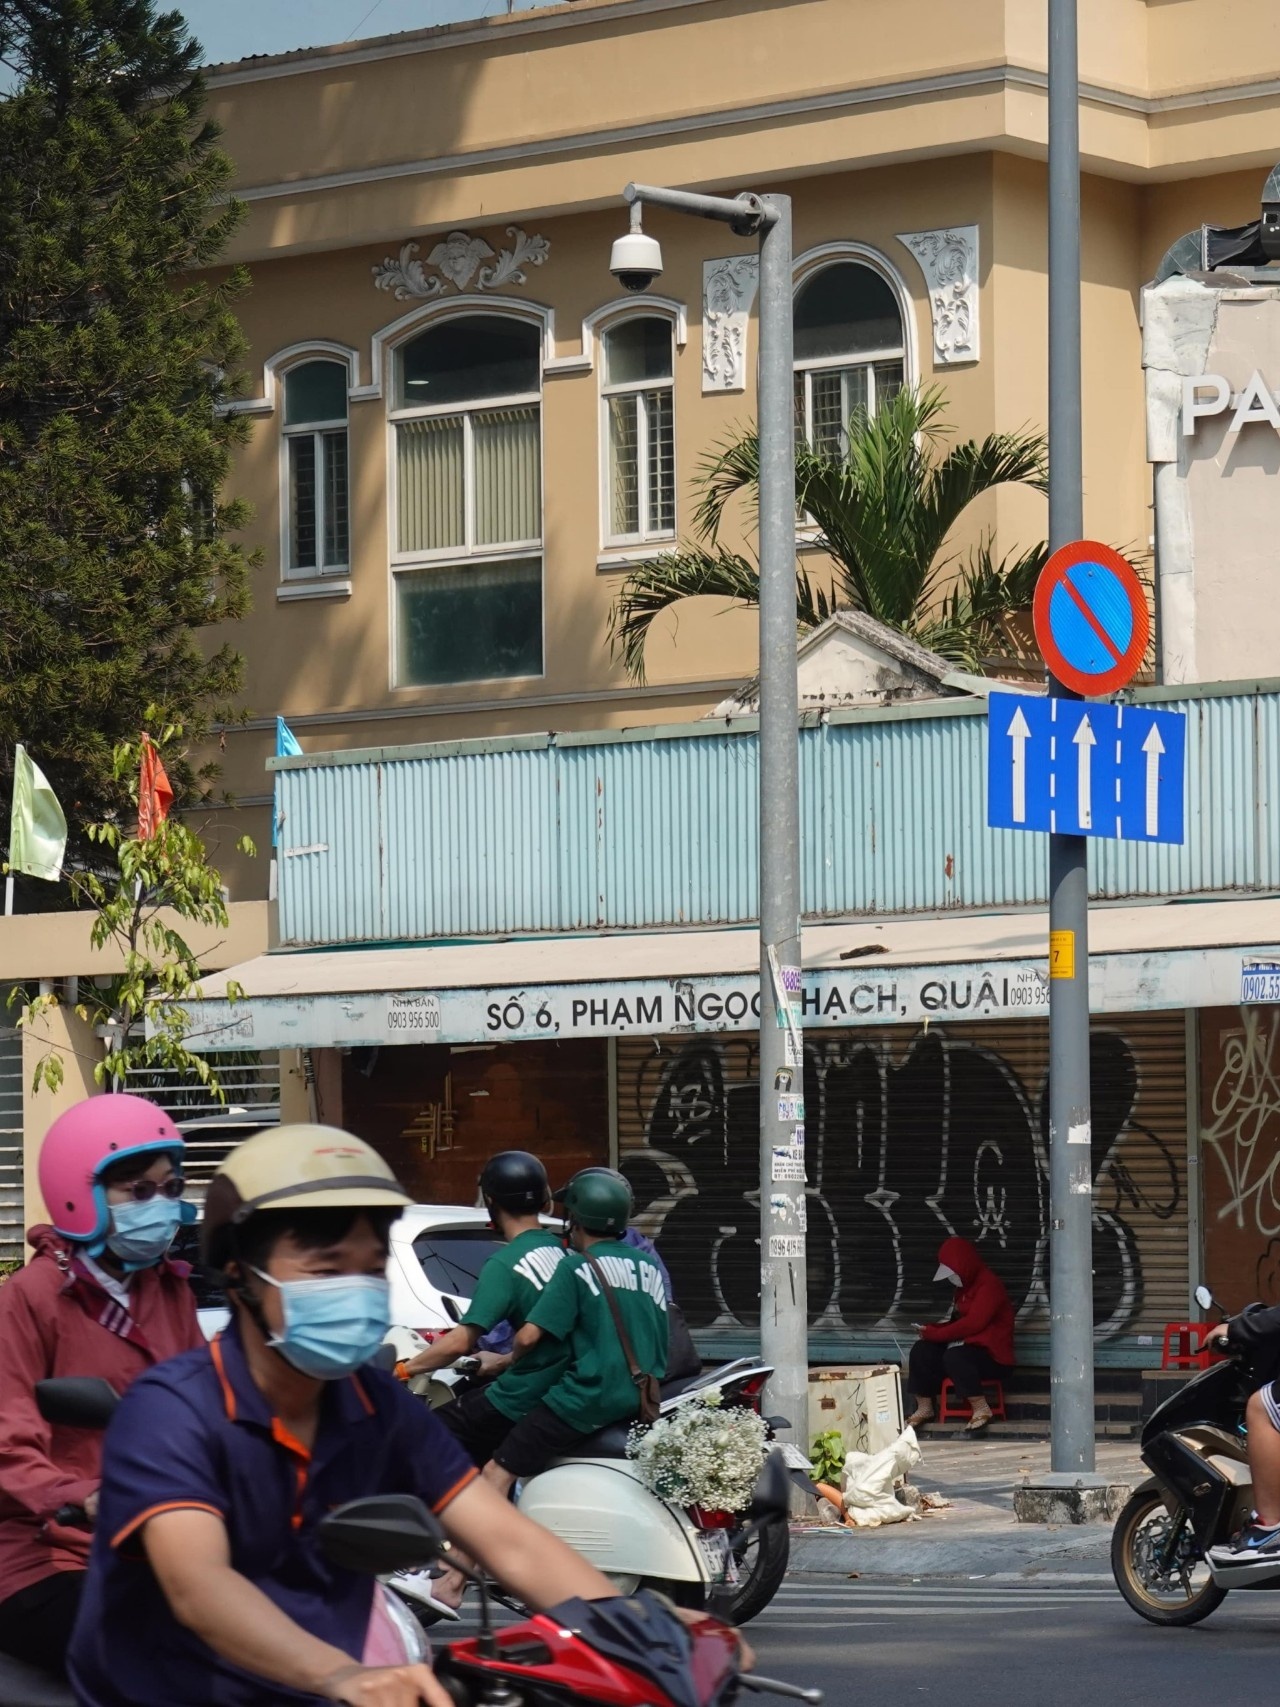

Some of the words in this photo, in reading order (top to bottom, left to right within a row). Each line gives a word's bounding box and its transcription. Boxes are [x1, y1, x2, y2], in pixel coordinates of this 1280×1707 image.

[1011, 987, 1032, 1006] 0903
[388, 1012, 407, 1029] 0903
[409, 1011, 424, 1028] 956
[425, 1011, 440, 1028] 500
[487, 991, 525, 1031] SỐ
[535, 1000, 560, 1032] 6,
[573, 995, 663, 1026] PHẠM
